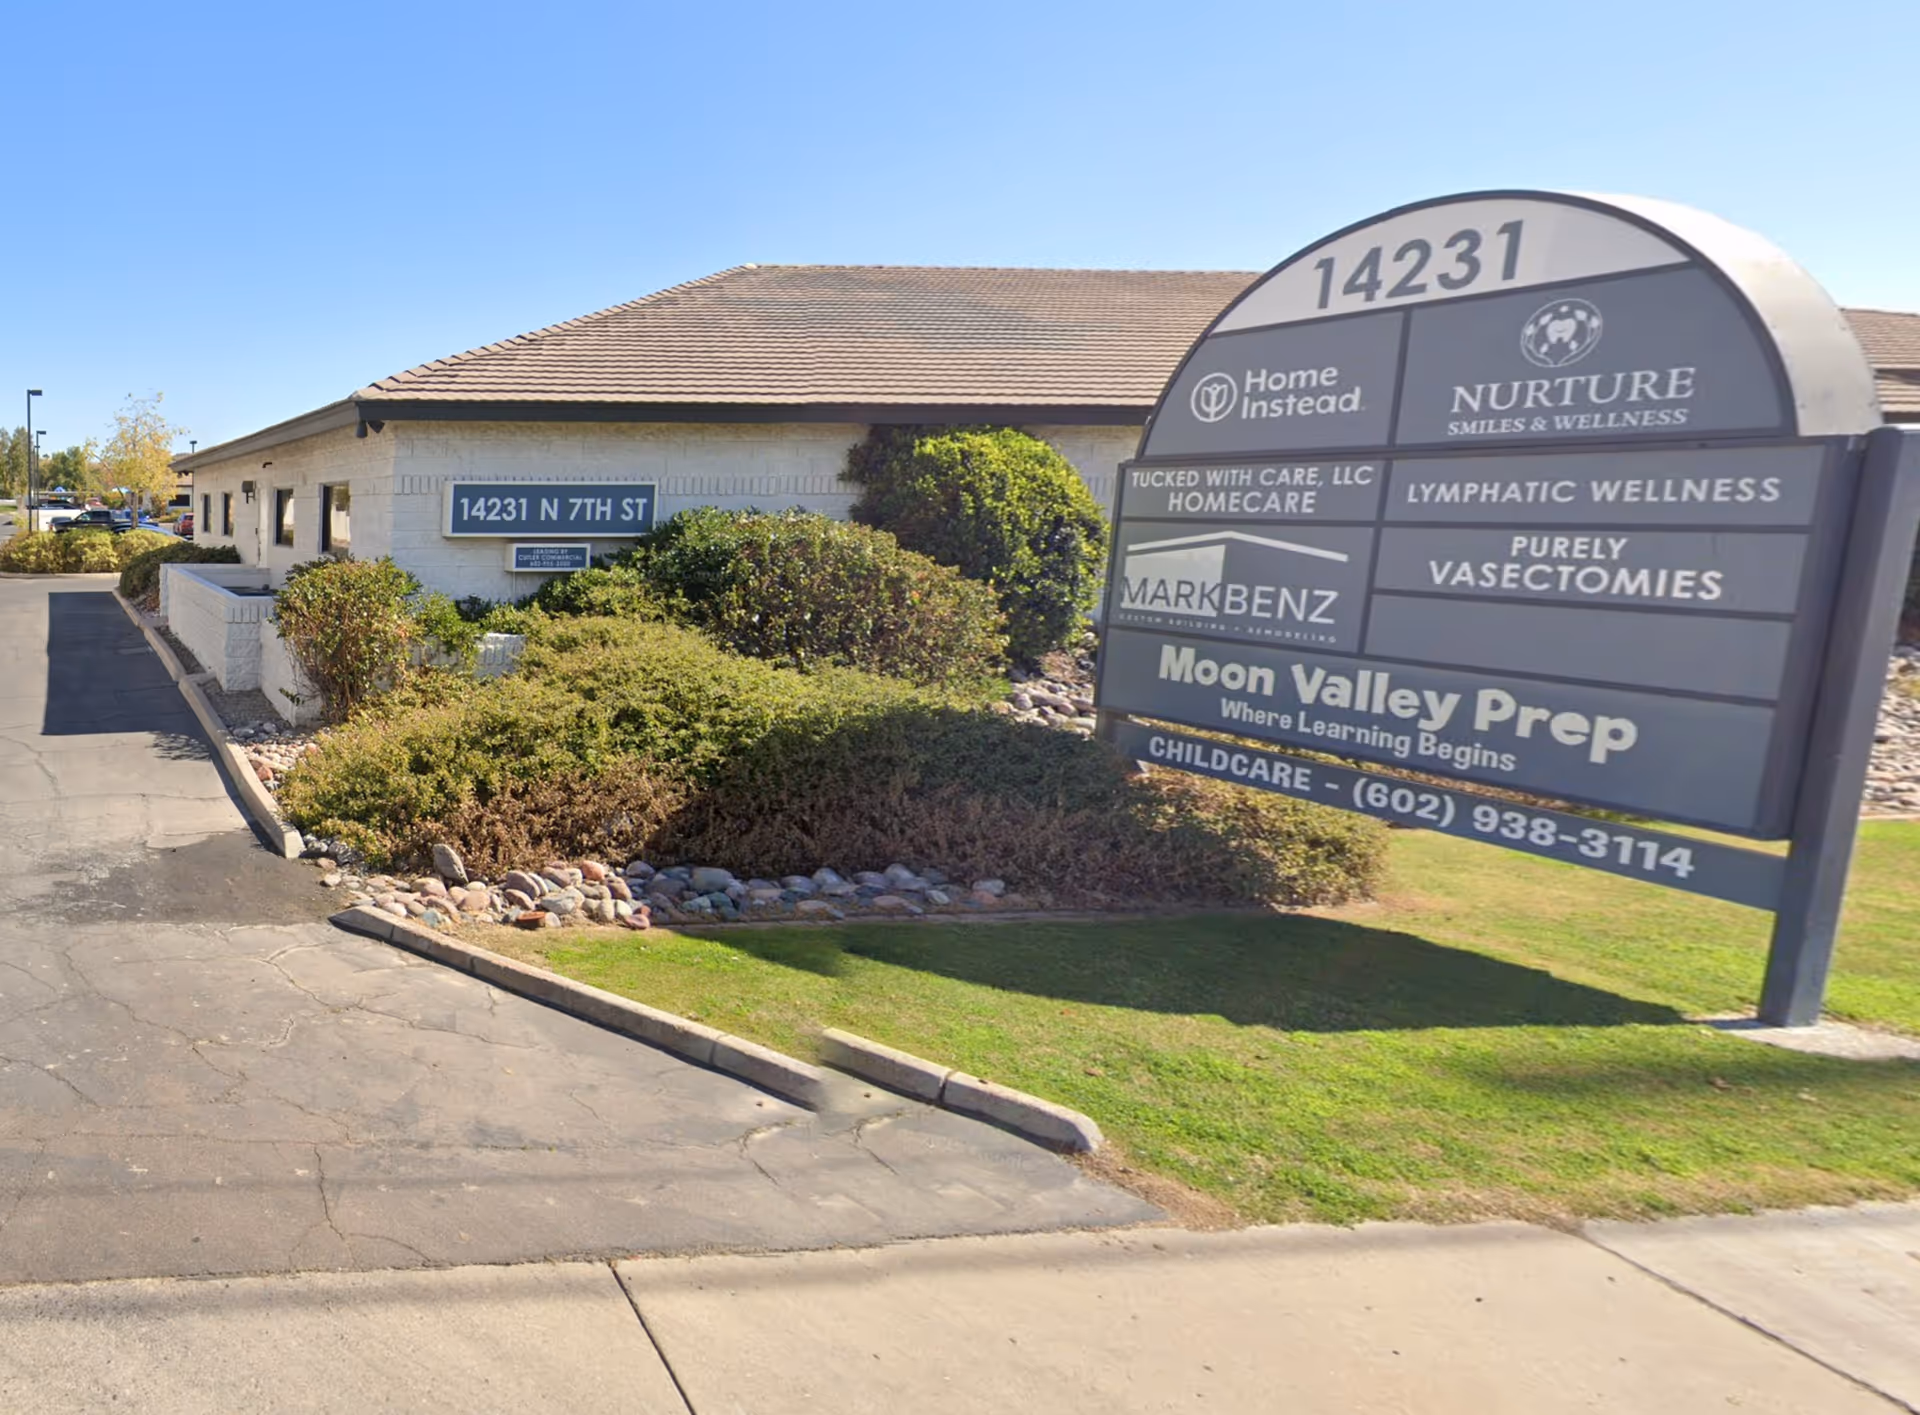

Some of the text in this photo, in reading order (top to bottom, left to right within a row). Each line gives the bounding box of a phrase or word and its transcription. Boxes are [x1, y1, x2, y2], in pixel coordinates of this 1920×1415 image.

[1313, 219, 1524, 310] 14231
[1245, 366, 1338, 393] Home
[1450, 366, 1696, 414] NURTURE
[1241, 386, 1363, 420] Instead
[1447, 408, 1690, 436] SMILES & WELLNESS
[1131, 465, 1375, 488] TUCKED WITH CARE, LLC
[1406, 477, 1782, 504] LYMPHATIC WELLNESS
[459, 497, 648, 522] 14231 N 7TH ST
[1167, 490, 1317, 514] HOMECARE
[1510, 535, 1629, 561] PURELY
[1428, 559, 1725, 601] VASECTOMIES
[1157, 644, 1639, 764] Moon Valley Prep
[1219, 696, 1518, 774] Where Learning Begins
[1148, 735, 1312, 793] CHILDCARE
[1351, 775, 1457, 830] (602)
[1472, 802, 1696, 880] 938-3114
